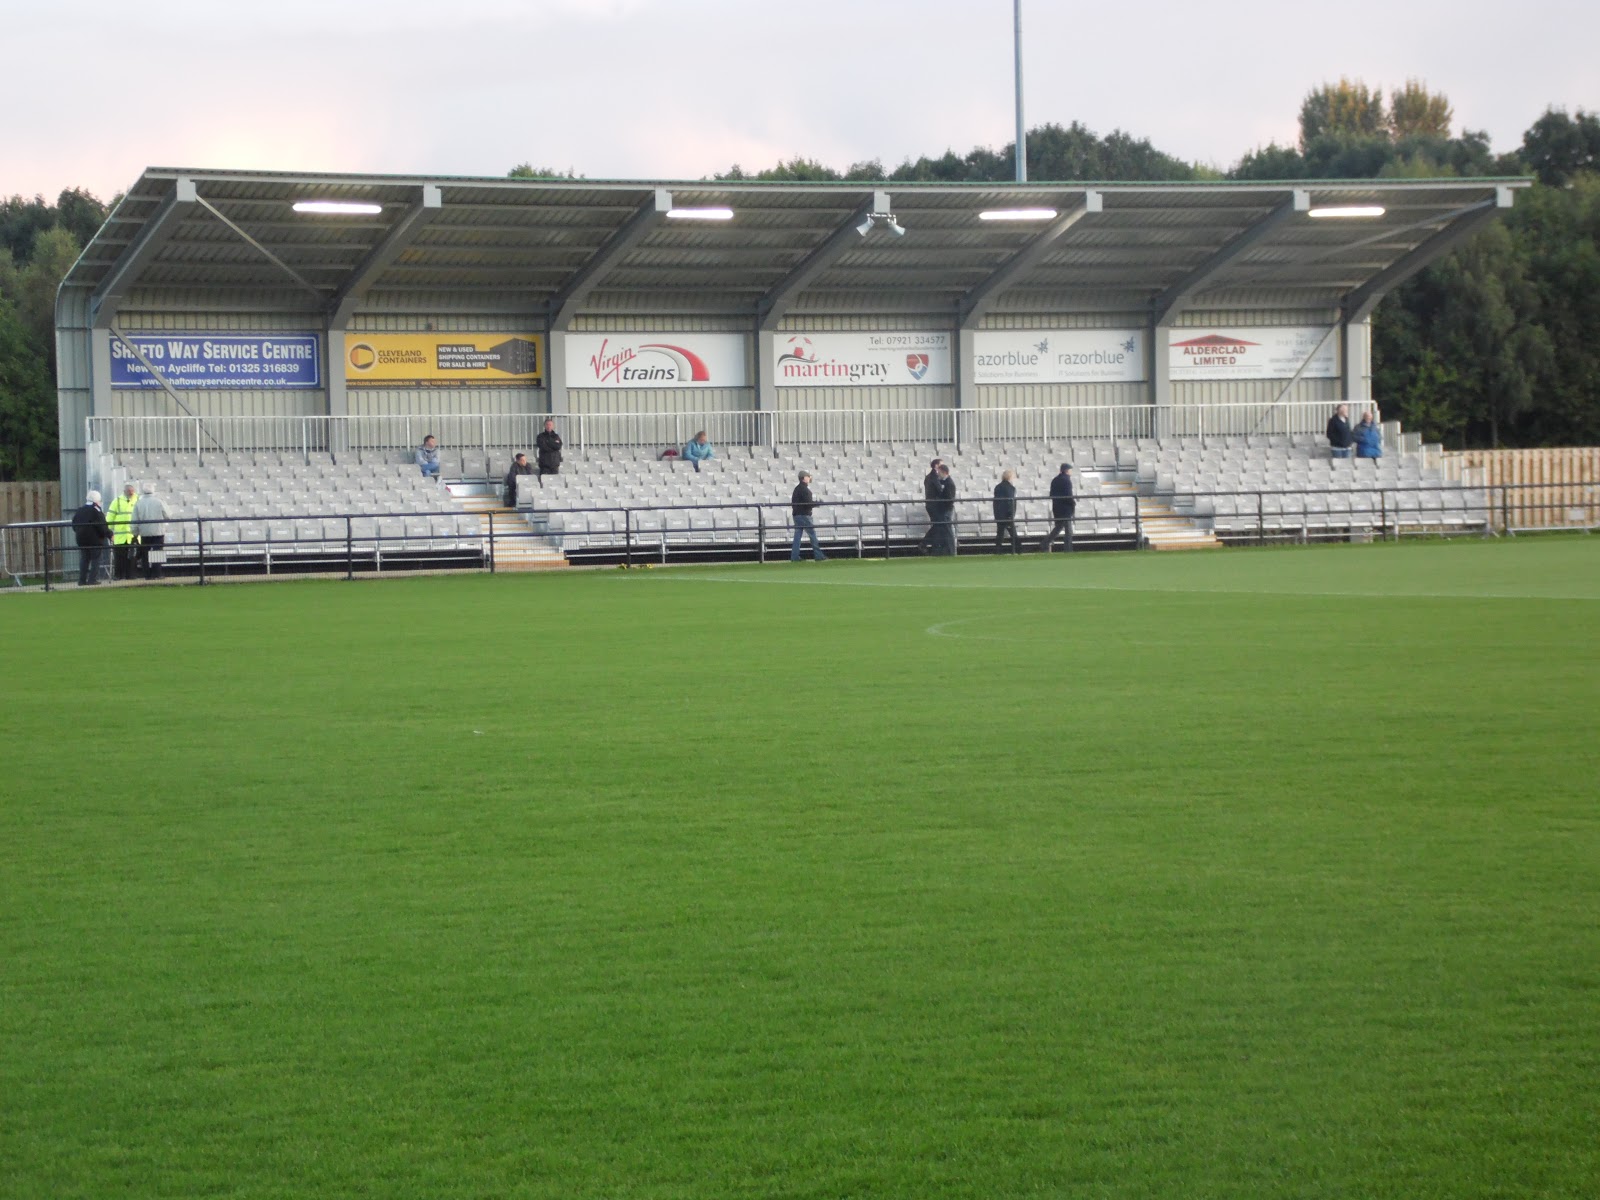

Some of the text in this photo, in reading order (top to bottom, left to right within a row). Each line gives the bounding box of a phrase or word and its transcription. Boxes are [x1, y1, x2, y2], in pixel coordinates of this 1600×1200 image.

[869, 336, 884, 345] Tel:
[886, 336, 912, 345] 07921
[167, 341, 199, 359] WAY
[203, 341, 259, 359] SERVICE
[262, 341, 312, 359] CENTRE
[1183, 346, 1246, 355] ALDERCLAD
[378, 356, 427, 364] CONTAINERS
[590, 338, 636, 383] Virgin
[1058, 350, 1124, 365] razorblue
[1193, 356, 1236, 366] LIMITED
[127, 363, 300, 375] Newon Aycliffe Tel: 01325 316839
[623, 366, 675, 380] trains
[783, 359, 890, 382] martingray
[141, 377, 287, 387] www.haftowayservicecentre.co.uk
